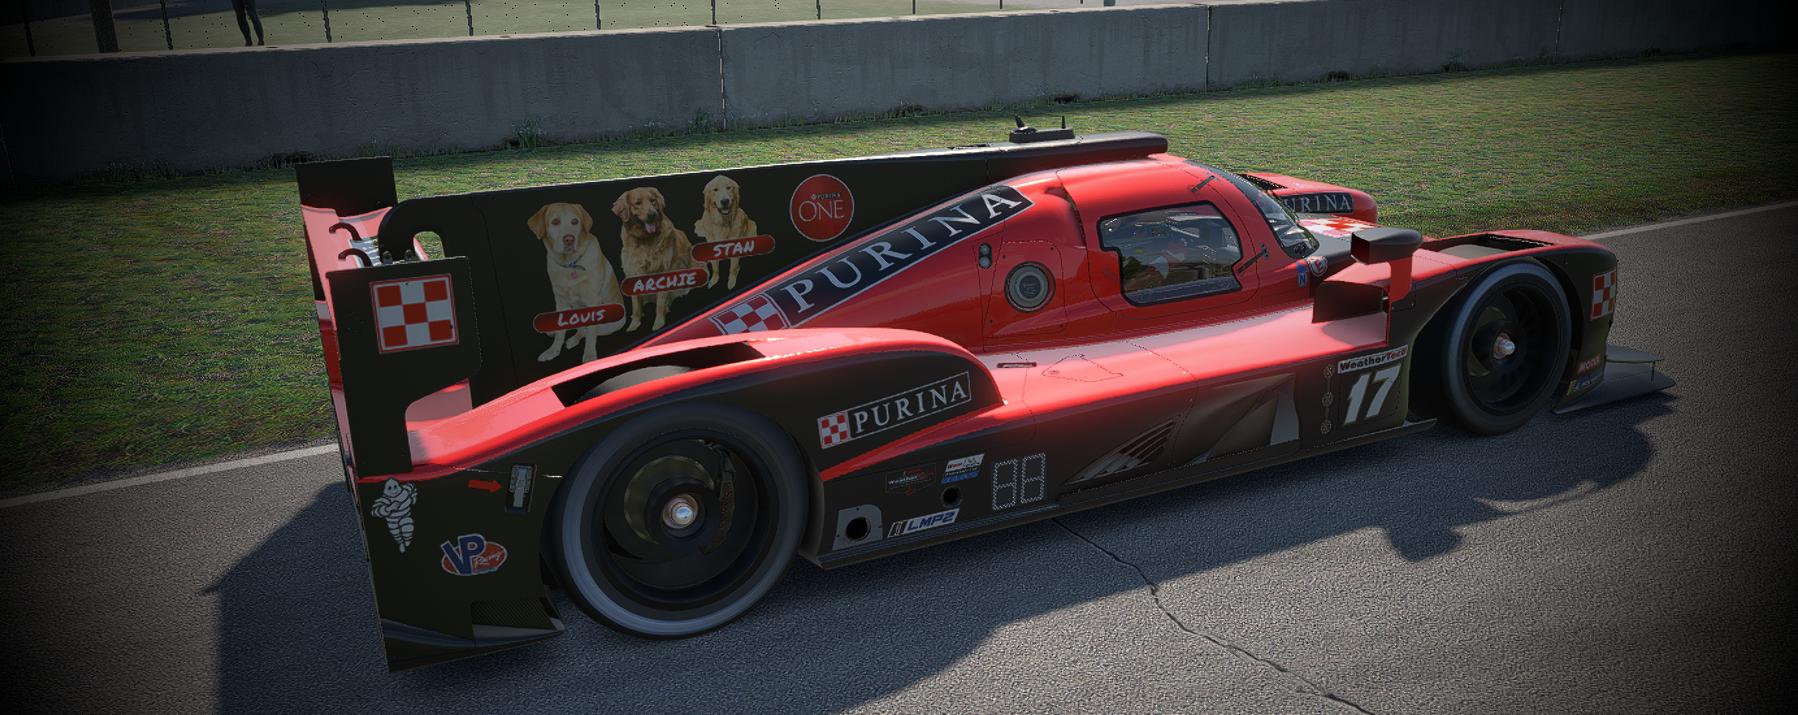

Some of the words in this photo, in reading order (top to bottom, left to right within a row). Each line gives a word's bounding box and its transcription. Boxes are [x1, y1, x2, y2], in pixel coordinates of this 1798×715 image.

[798, 199, 845, 223] ONE
[1284, 194, 1352, 212] URINA
[714, 240, 755, 257] STAN
[781, 190, 1022, 313] PURINA
[632, 272, 697, 293] ARCHIE
[557, 309, 605, 327] LOUIS
[1344, 363, 1401, 424] 17
[854, 380, 967, 434] PURINA
[907, 511, 956, 531] LMP2
[441, 533, 486, 576] VP
